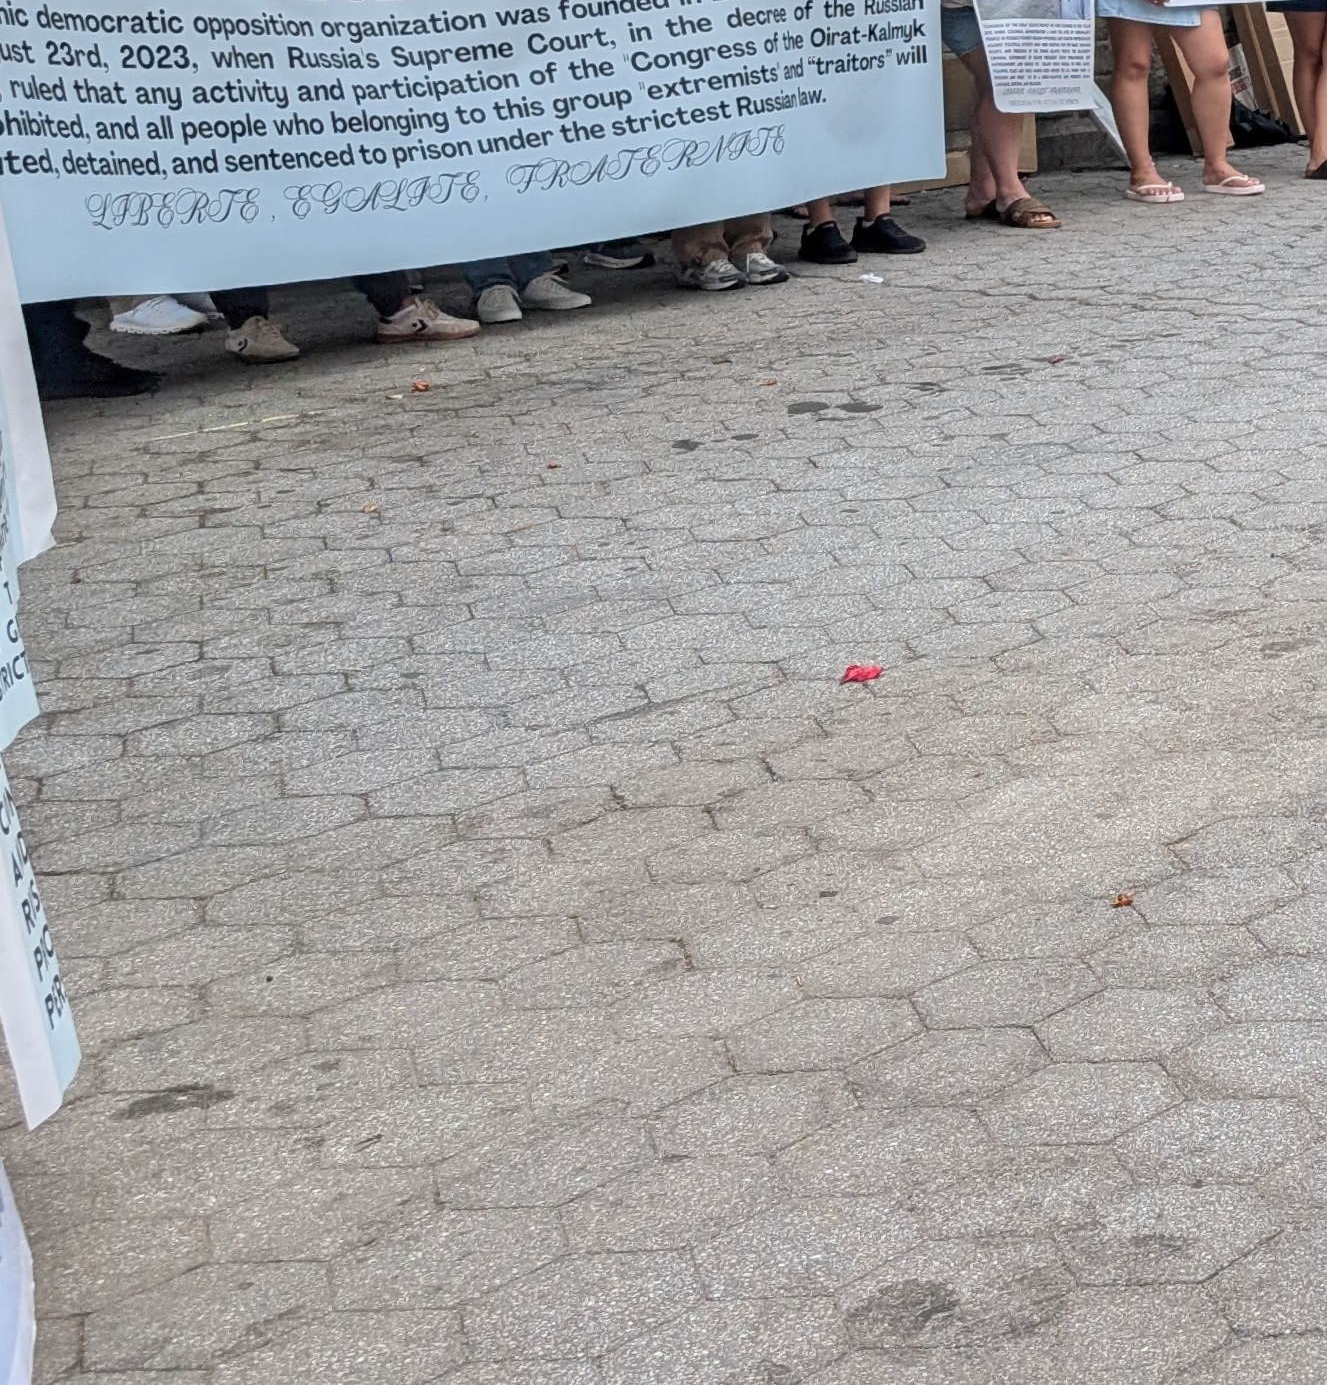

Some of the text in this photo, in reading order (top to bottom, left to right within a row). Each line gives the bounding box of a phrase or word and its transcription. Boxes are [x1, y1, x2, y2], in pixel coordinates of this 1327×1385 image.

[9, 74, 68, 102] ruled
[73, 78, 127, 104] that
[135, 86, 182, 111] any
[192, 79, 289, 109] activity
[297, 78, 345, 102] and
[351, 70, 520, 106] participation
[529, 62, 557, 85] of
[568, 58, 615, 81] the
[764, 31, 779, 54] of
[782, 30, 804, 51] the
[810, 18, 926, 50] Oirat-Kalmyk
[36, 4, 184, 34] democratic
[193, 11, 314, 41] opposition
[320, 10, 487, 43] organization
[495, 7, 551, 26] was
[46, 40, 109, 73] 23rd,
[120, 45, 198, 74] 2023,
[211, 45, 274, 69] when
[391, 42, 514, 71] Supreme
[527, 27, 616, 55] Court,
[629, 22, 652, 43] in
[665, 15, 713, 37] the
[727, 7, 787, 28] decree
[794, 0, 814, 21] of
[0, 86, 826, 180] ted, detained, and sentenced to prison under the strictest Russian law.
[95, 115, 140, 140] and
[146, 115, 174, 140] all
[181, 113, 267, 146] people
[272, 112, 324, 136] who
[333, 104, 450, 136] belonging
[455, 105, 486, 125] to
[492, 96, 545, 121] this
[553, 89, 632, 119] group
[783, 57, 804, 80] and
[896, 45, 927, 66] will
